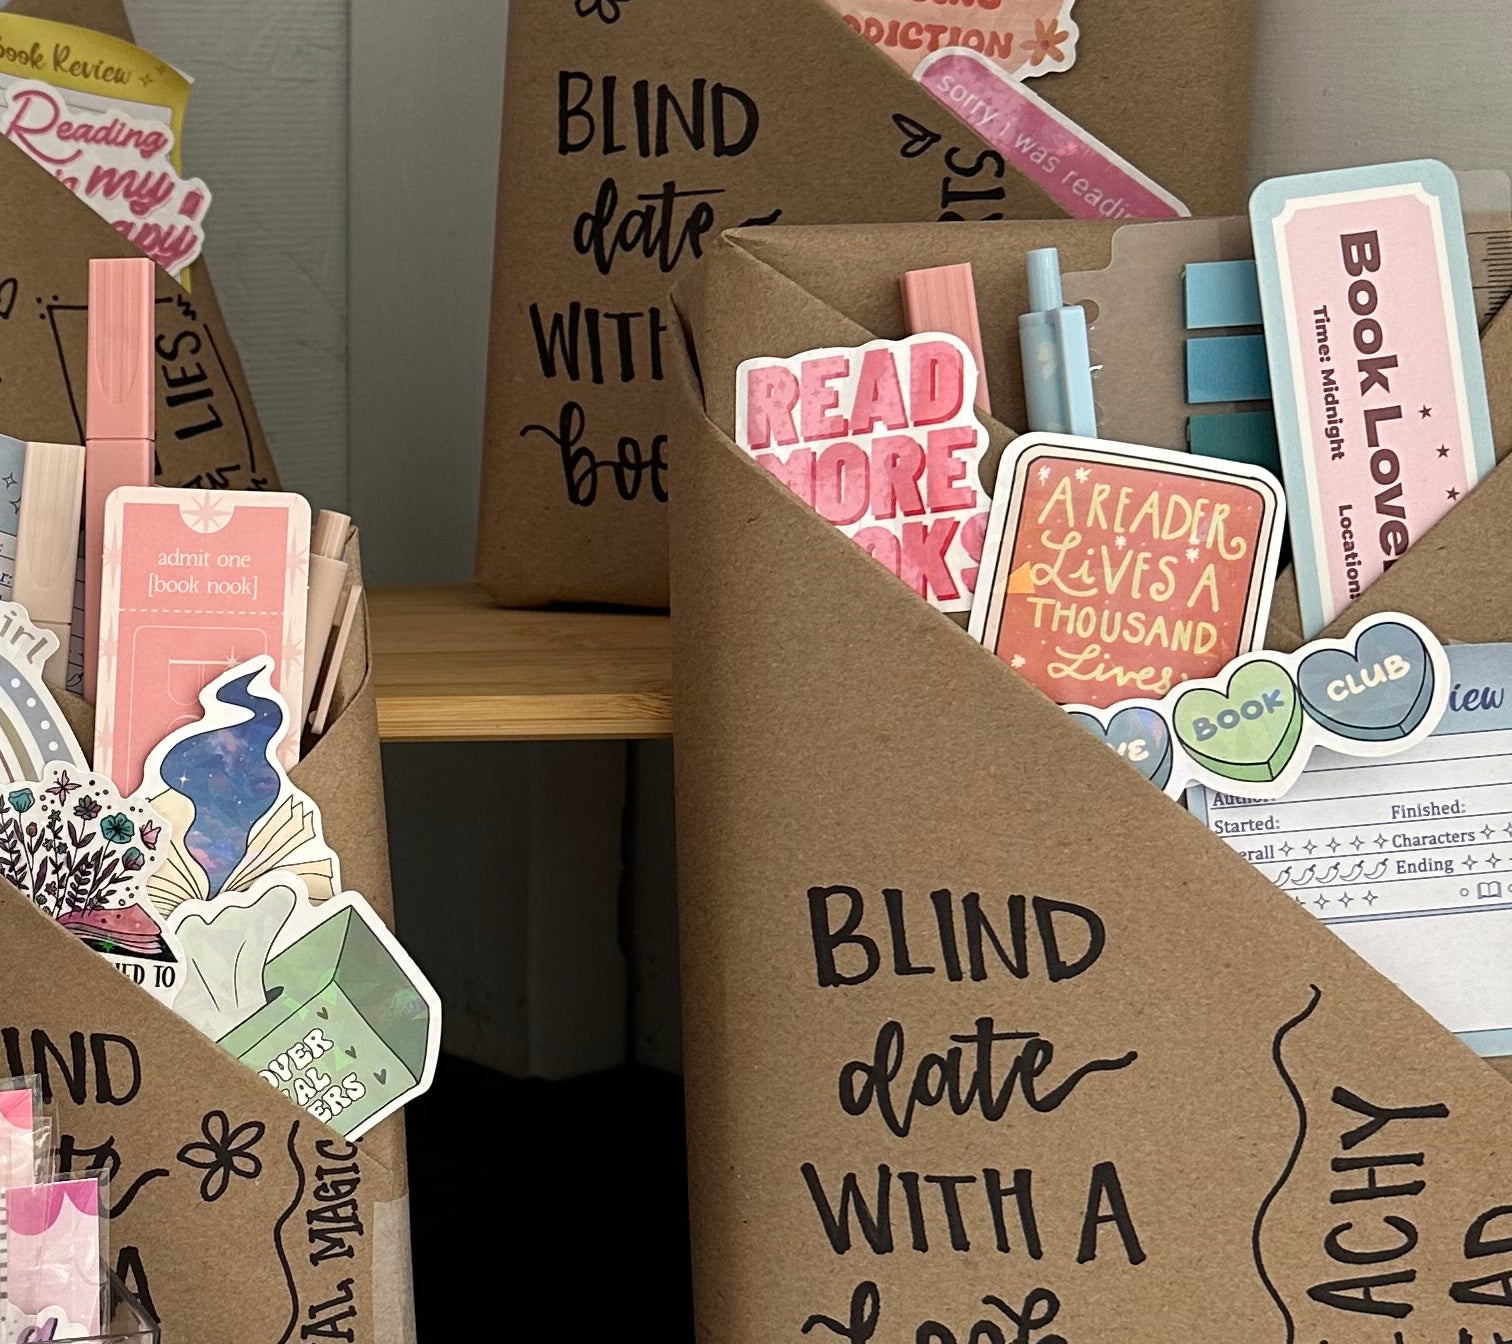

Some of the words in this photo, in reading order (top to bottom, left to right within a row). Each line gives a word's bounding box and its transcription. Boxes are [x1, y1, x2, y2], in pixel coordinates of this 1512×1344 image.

[52, 43, 131, 86] Review
[5, 89, 169, 164] Reading
[558, 71, 760, 157] BLIND
[936, 75, 998, 128] sorry
[1015, 133, 1060, 175] was
[85, 165, 175, 217] my
[573, 177, 782, 275] date
[1313, 305, 1331, 364] Time:
[1340, 229, 1399, 396] Book
[747, 340, 964, 450] READ
[1321, 367, 1346, 461] Midnight
[158, 548, 209, 568] admit
[217, 553, 251, 568] one
[1038, 477, 1074, 528] A
[1087, 483, 1246, 560] READER
[1338, 503, 1362, 600] Location:
[148, 573, 199, 598] [book
[207, 575, 258, 600] nook]
[1026, 596, 1217, 655] THOUSAND
[1187, 564, 1219, 612] A
[1193, 689, 1284, 742] BOOK
[1326, 655, 1411, 702] CLUB
[1214, 816, 1280, 834] Started:
[1391, 800, 1467, 820] Finished:
[1392, 830, 1475, 848] Characters
[1396, 857, 1454, 875] Ending
[153, 965, 176, 988] TO
[808, 885, 1105, 988] BLIND
[838, 1017, 1138, 1138] date
[308, 1136, 364, 1266] MAGIC
[800, 1162, 1044, 1260] WITH
[1077, 1161, 1146, 1265] A
